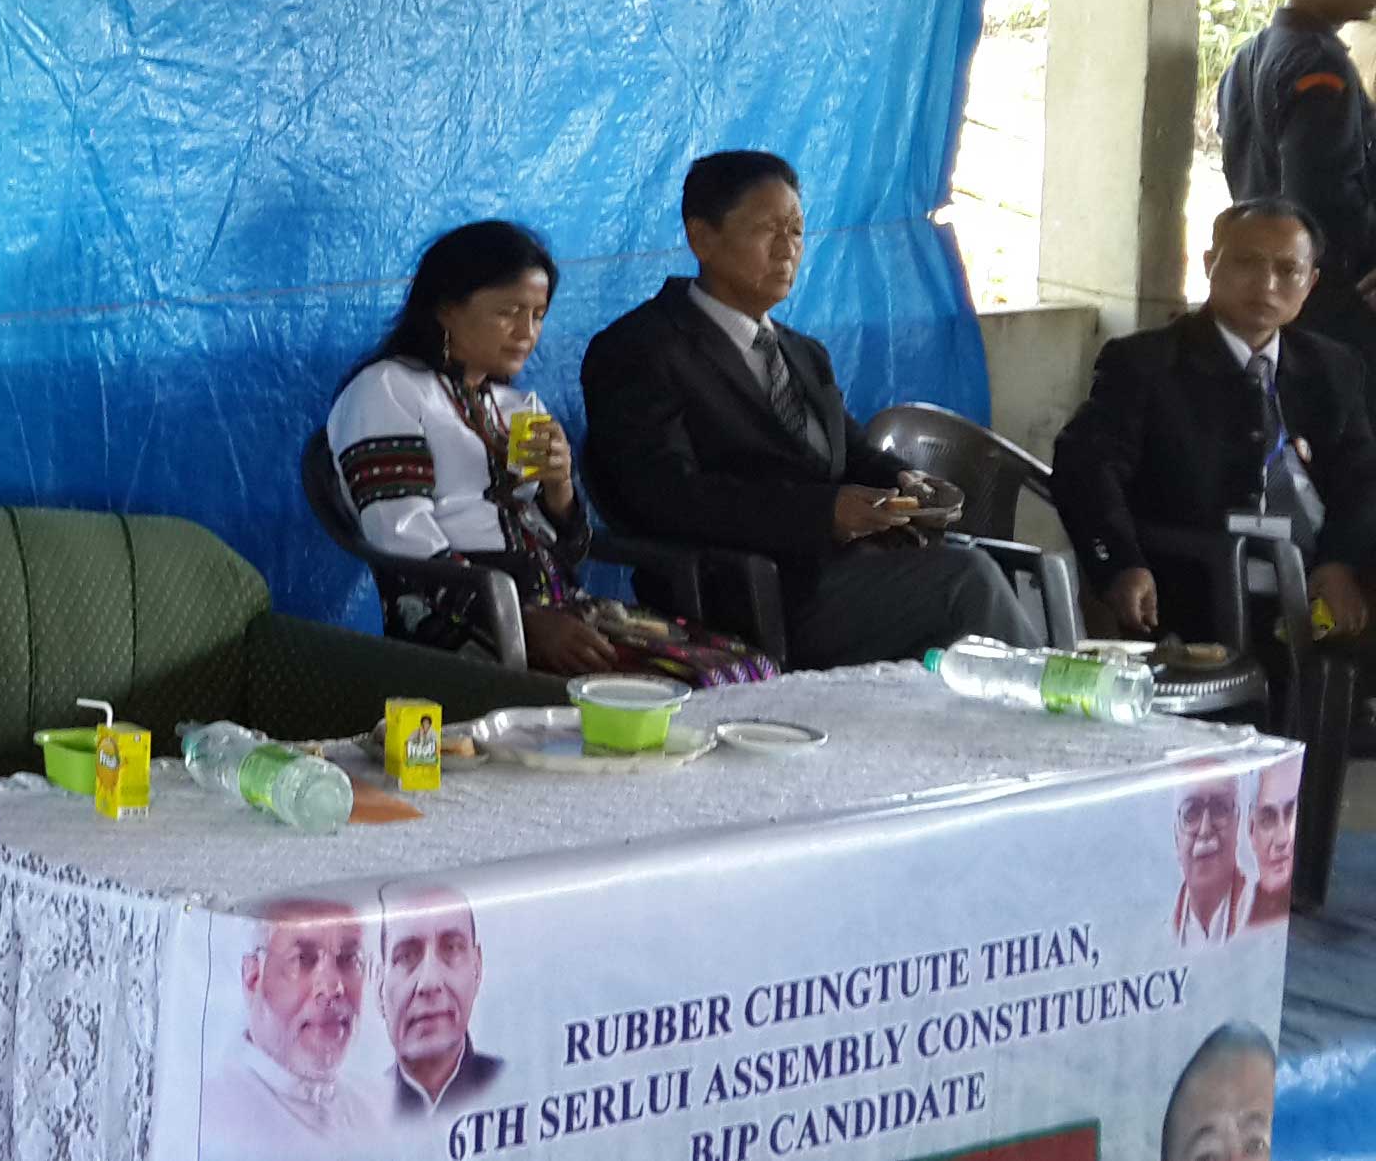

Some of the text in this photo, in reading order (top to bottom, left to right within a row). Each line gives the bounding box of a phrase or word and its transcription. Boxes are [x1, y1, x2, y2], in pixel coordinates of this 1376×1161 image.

[449, 967, 1190, 1161] 6TH SERLUI ASSEMBLY CONSTITUENCY
[564, 923, 1100, 1066] RUBBER CHINGTUTE THIAN,
[692, 1072, 987, 1161] BJP CANDIDATE
